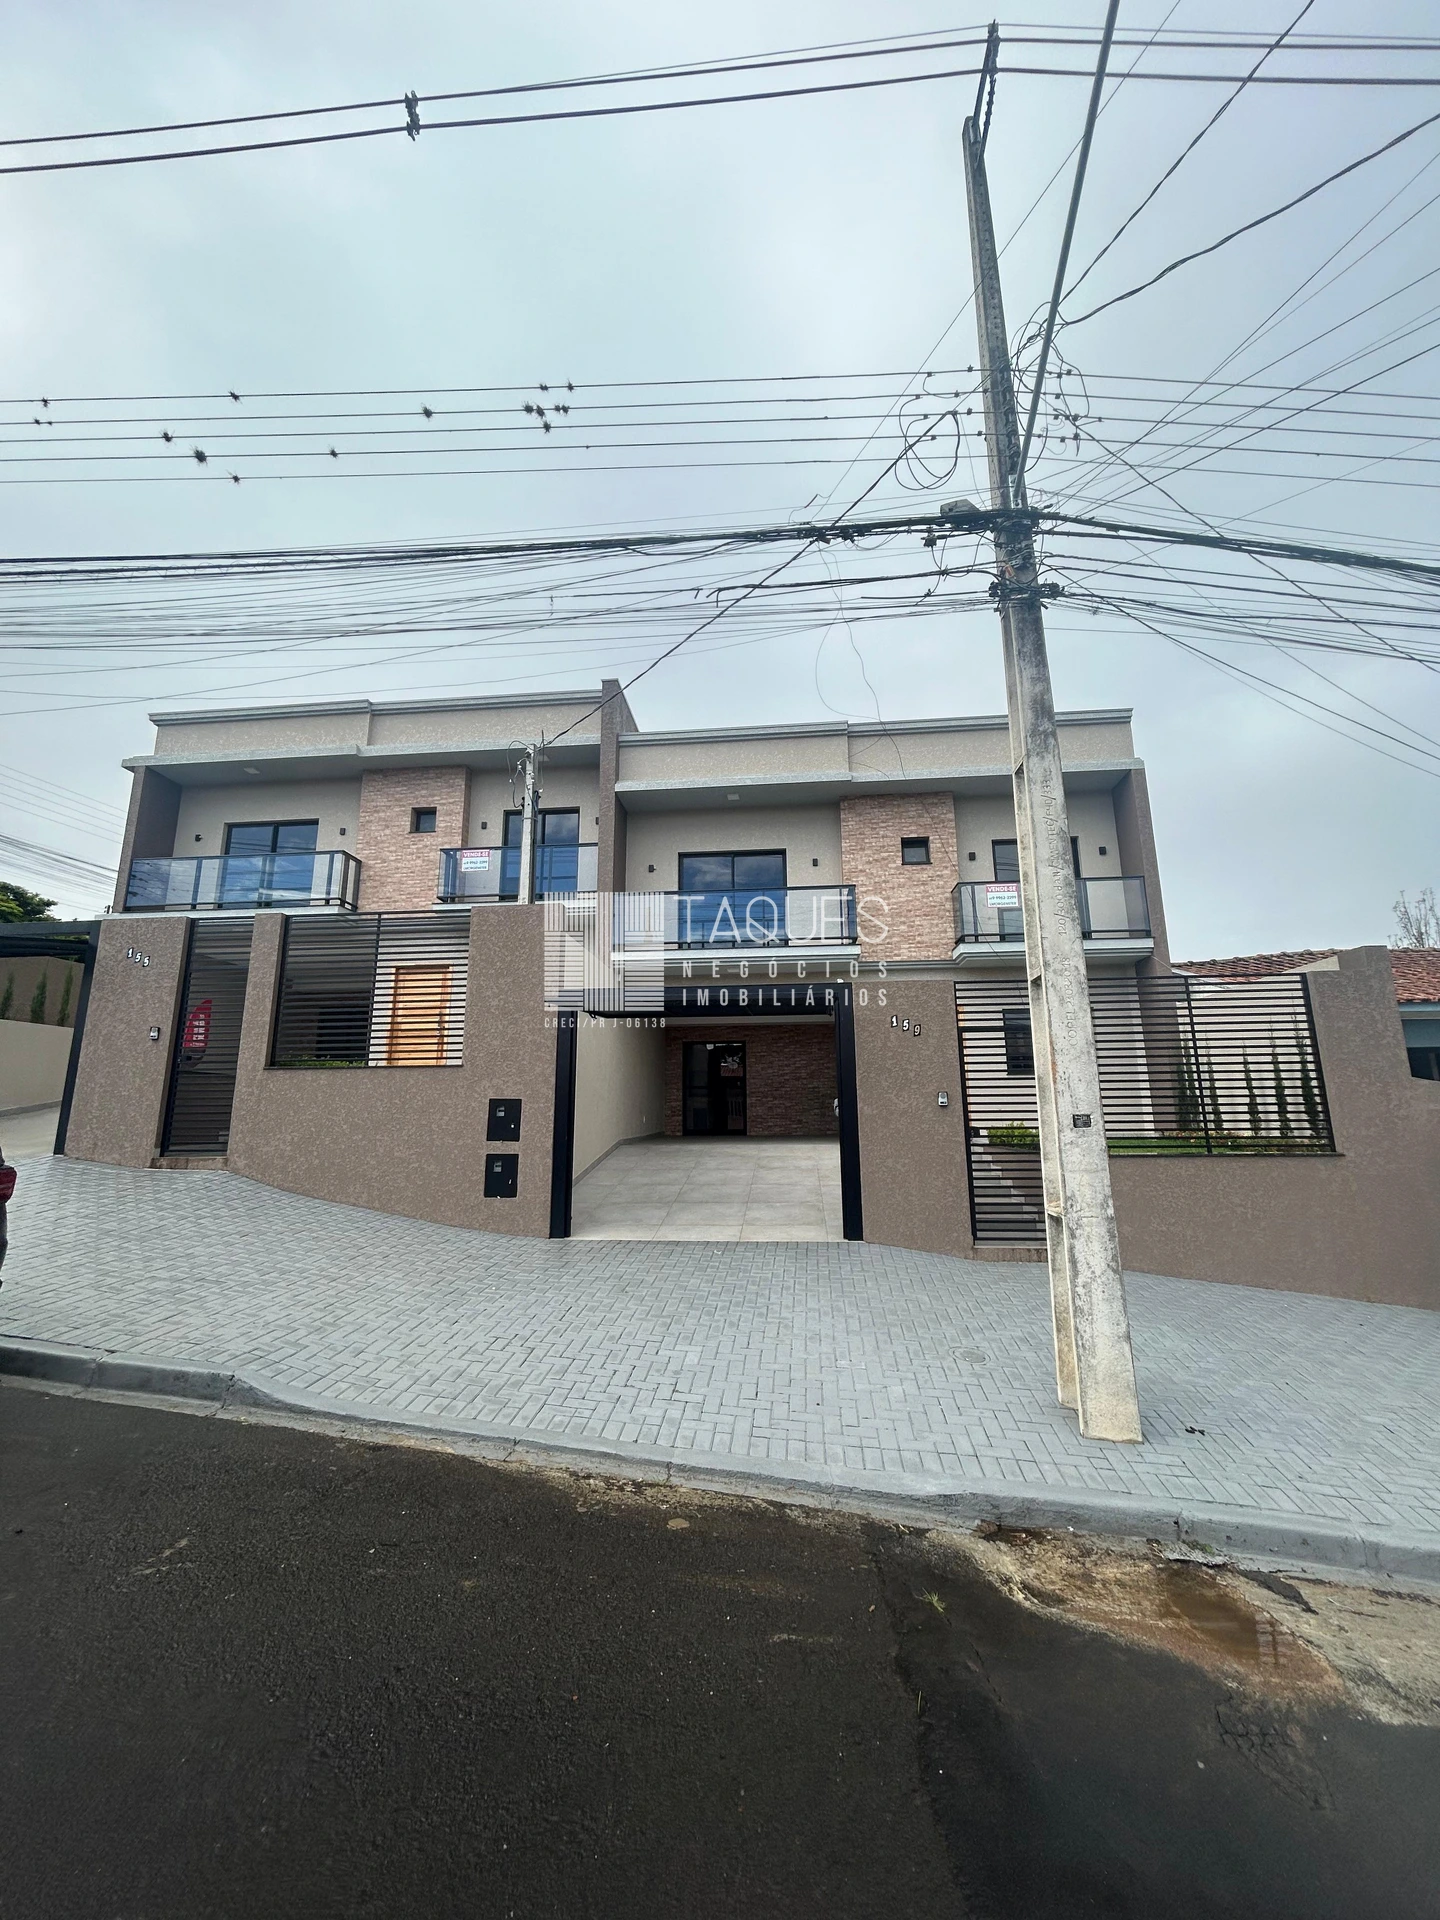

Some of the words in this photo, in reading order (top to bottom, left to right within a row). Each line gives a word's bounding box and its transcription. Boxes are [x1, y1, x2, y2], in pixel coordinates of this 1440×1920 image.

[127, 947, 150, 967] 155
[891, 1015, 921, 1036] 159
[1065, 1008, 1079, 1047] COPEL
